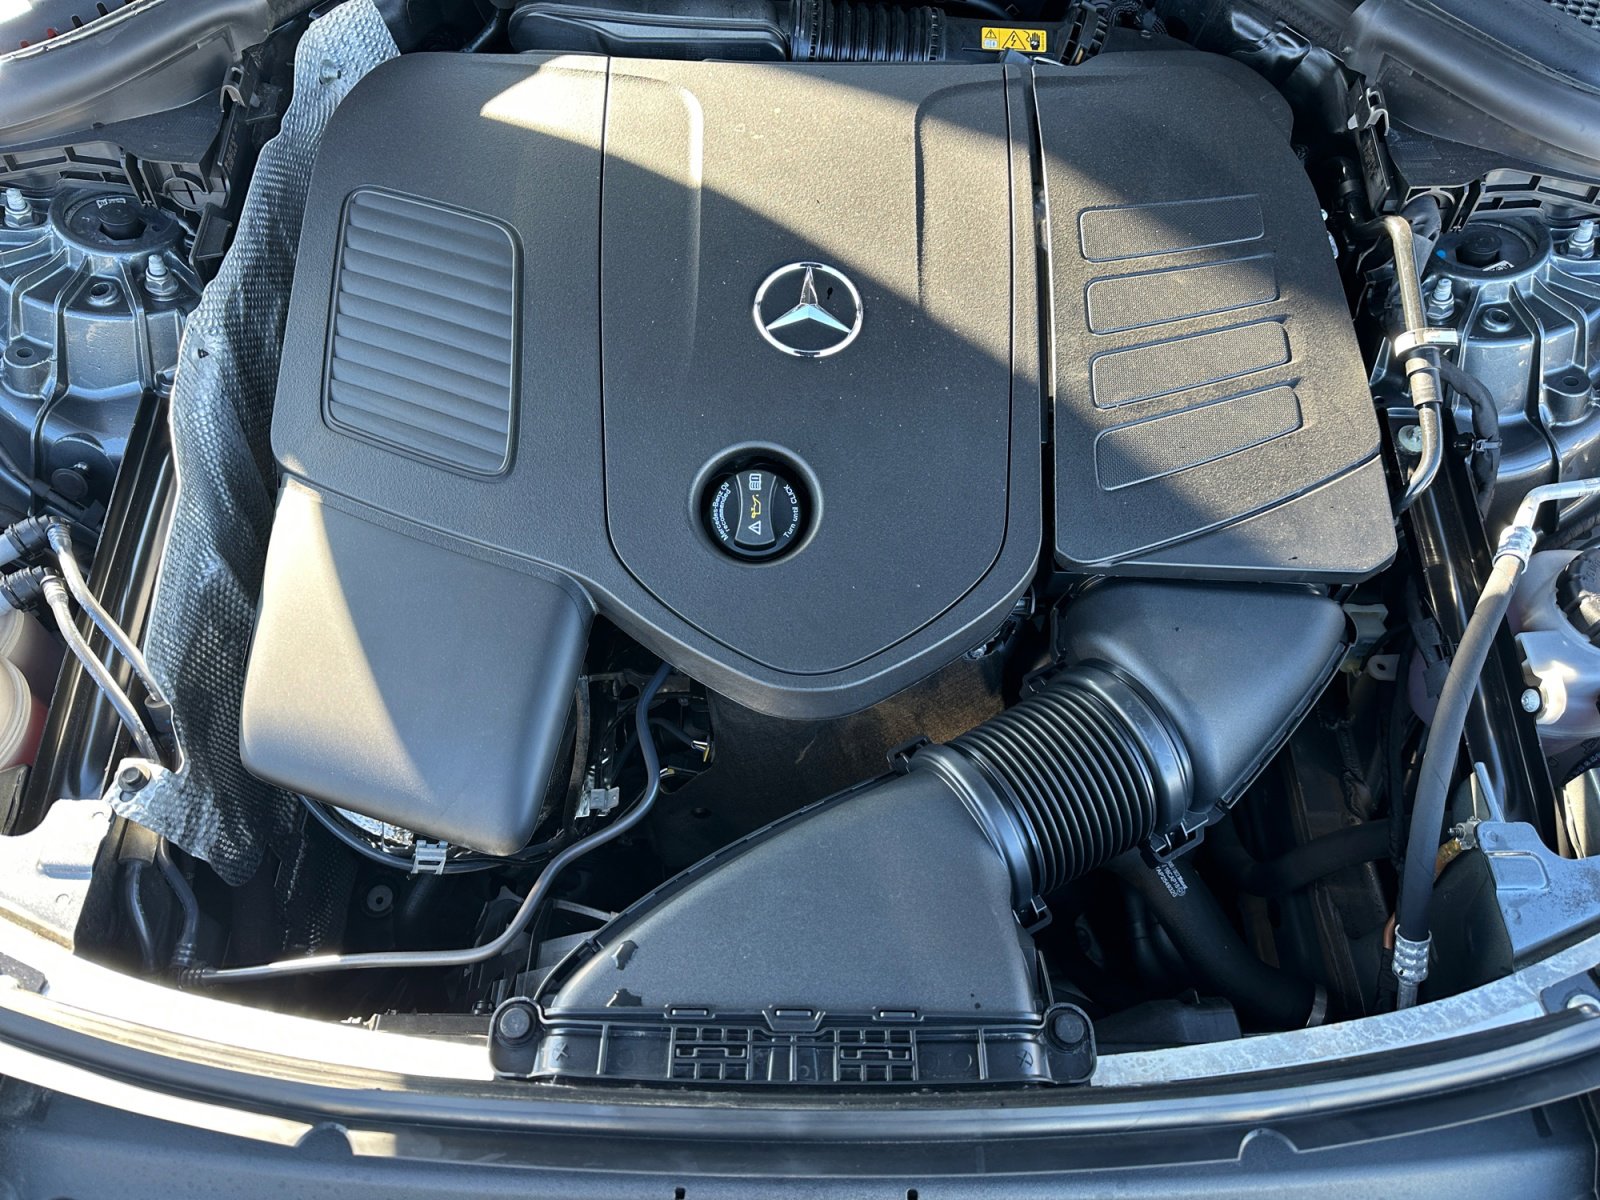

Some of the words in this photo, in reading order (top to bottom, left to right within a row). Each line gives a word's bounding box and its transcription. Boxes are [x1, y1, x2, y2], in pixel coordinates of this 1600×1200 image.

[783, 484, 797, 504] CLICK
[712, 490, 728, 541] Mercedes-Benz
[720, 481, 729, 490] Oil
[719, 489, 731, 532] recommended
[783, 523, 796, 538] Turn
